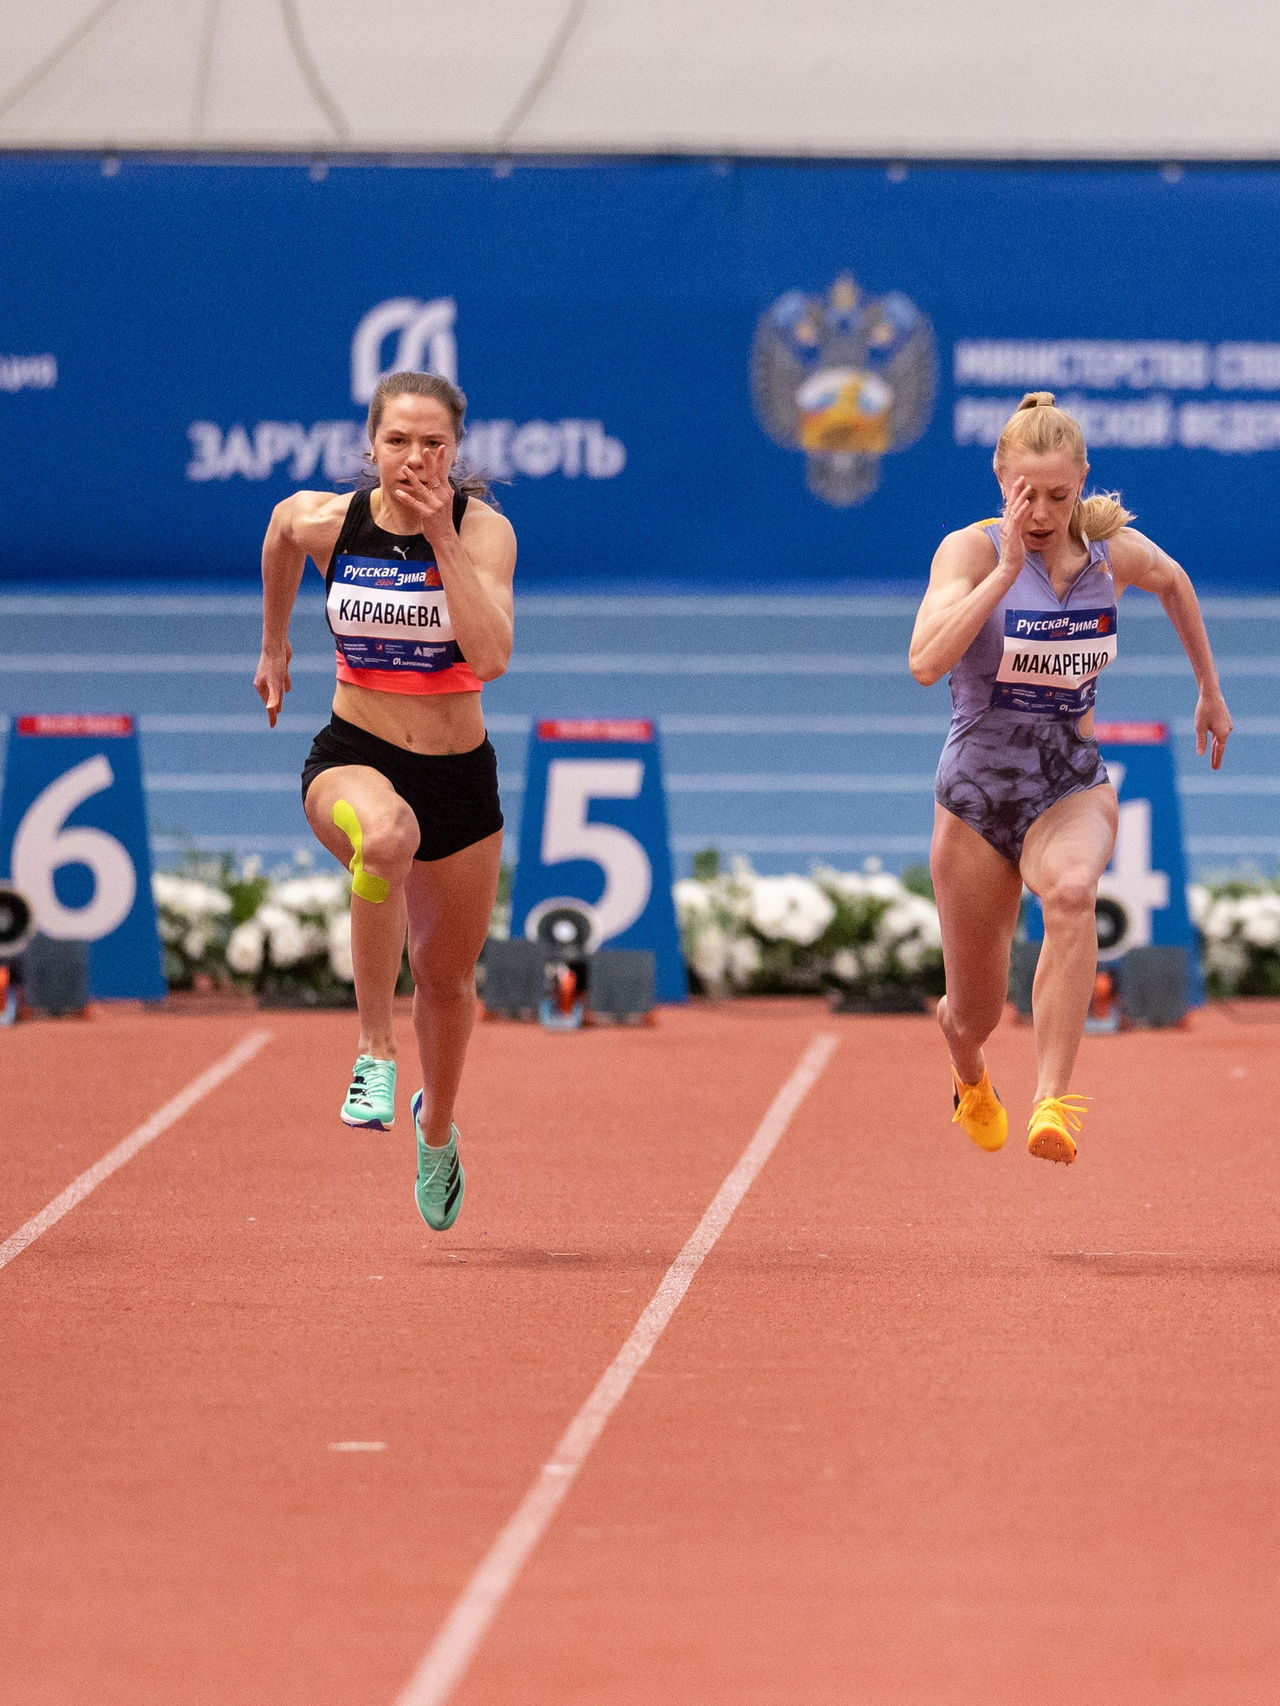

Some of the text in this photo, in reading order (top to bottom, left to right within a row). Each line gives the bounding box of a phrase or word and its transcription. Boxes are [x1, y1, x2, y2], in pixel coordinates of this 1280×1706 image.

[955, 341, 1208, 388] МИНИСТЕРСТВО
[343, 565, 426, 585] Русская Зима
[339, 599, 441, 628] КАРАВАЕВА
[1016, 617, 1099, 635] Русская Зима
[1012, 651, 1109, 676] МАКАРЕНКО
[11, 754, 136, 941] 6
[542, 759, 652, 948] 5
